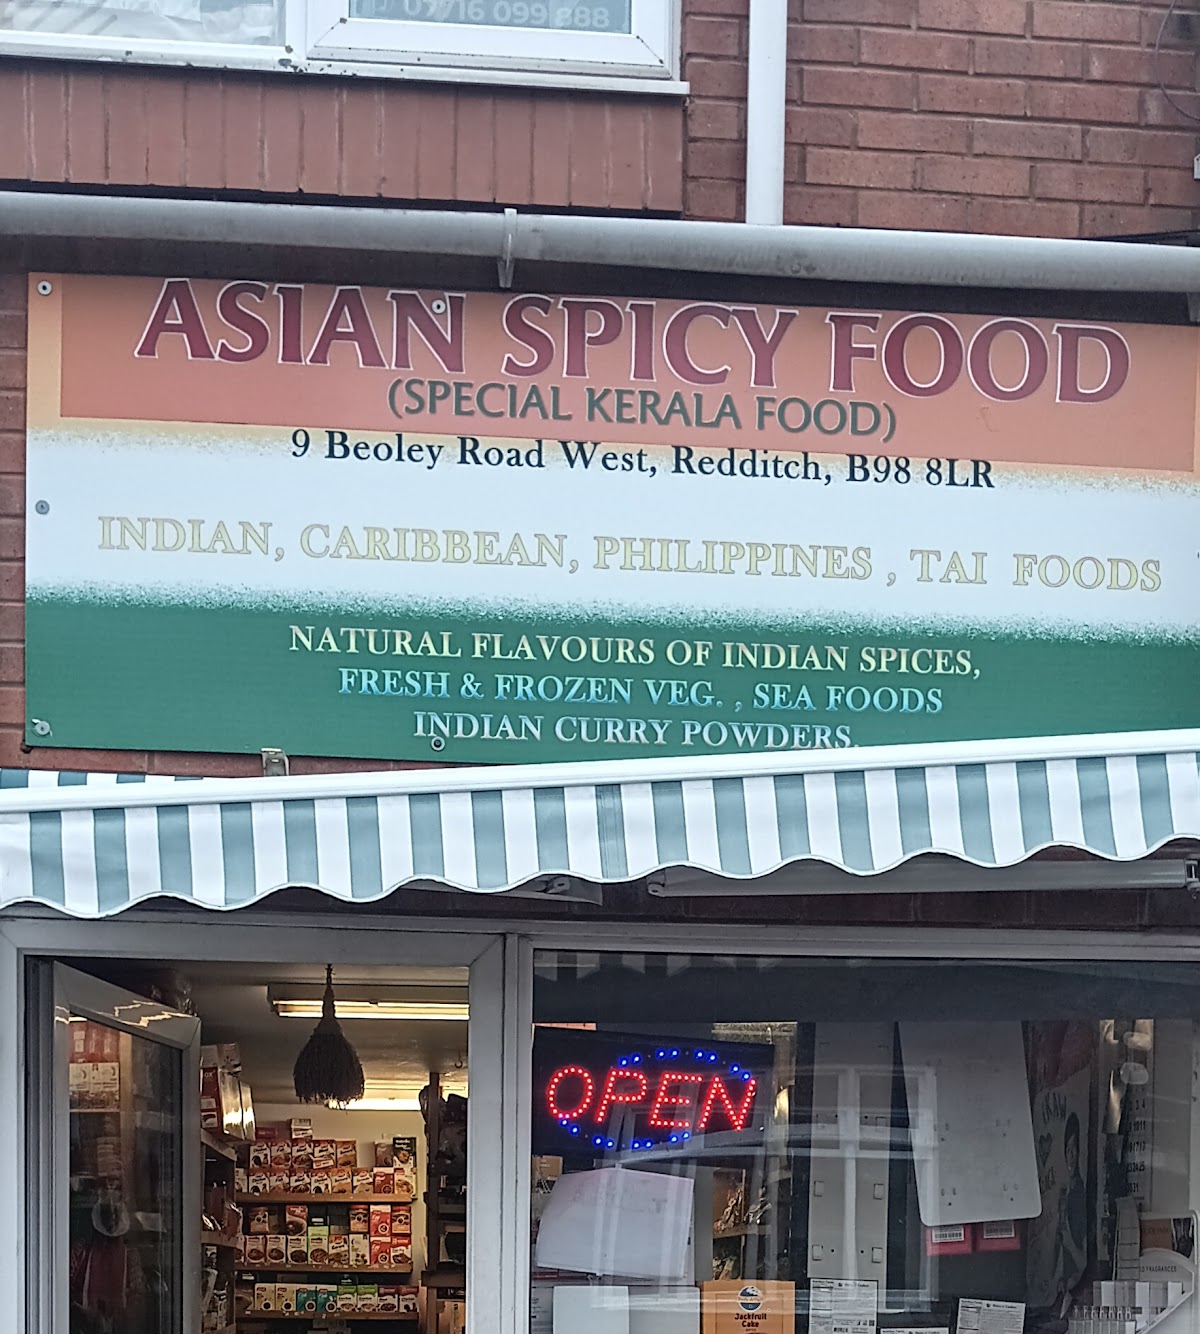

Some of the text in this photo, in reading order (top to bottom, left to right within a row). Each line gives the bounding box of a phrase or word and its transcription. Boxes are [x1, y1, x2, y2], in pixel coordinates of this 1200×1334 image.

[493, 1, 548, 24] 099
[555, 6, 610, 28] 888
[134, 278, 1131, 404] ASIAN SPICY FOOD
[388, 377, 897, 442] (SPECIAL KERALA FOOD)
[291, 430, 995, 488] 9 Beoley Road West, Redditch, B98 8LR
[98, 516, 285, 562] INDIAN,
[299, 524, 579, 574] CARIBBEAN,
[593, 536, 872, 581] PHILIPPINES
[910, 549, 987, 586] TAI
[1012, 553, 1161, 592] FOODS
[289, 625, 981, 680] NATURAL FLAVOURS OF INDIAN SPICES,
[338, 667, 450, 699] FRESH
[460, 672, 485, 700] &
[493, 673, 634, 705] FROZEN
[643, 678, 723, 708] VEG.
[753, 683, 817, 710] SEA
[825, 685, 944, 713] FOODS
[414, 710, 545, 742] INDIAN
[553, 715, 673, 747] CURRY
[546, 1066, 757, 1132] OPEN
